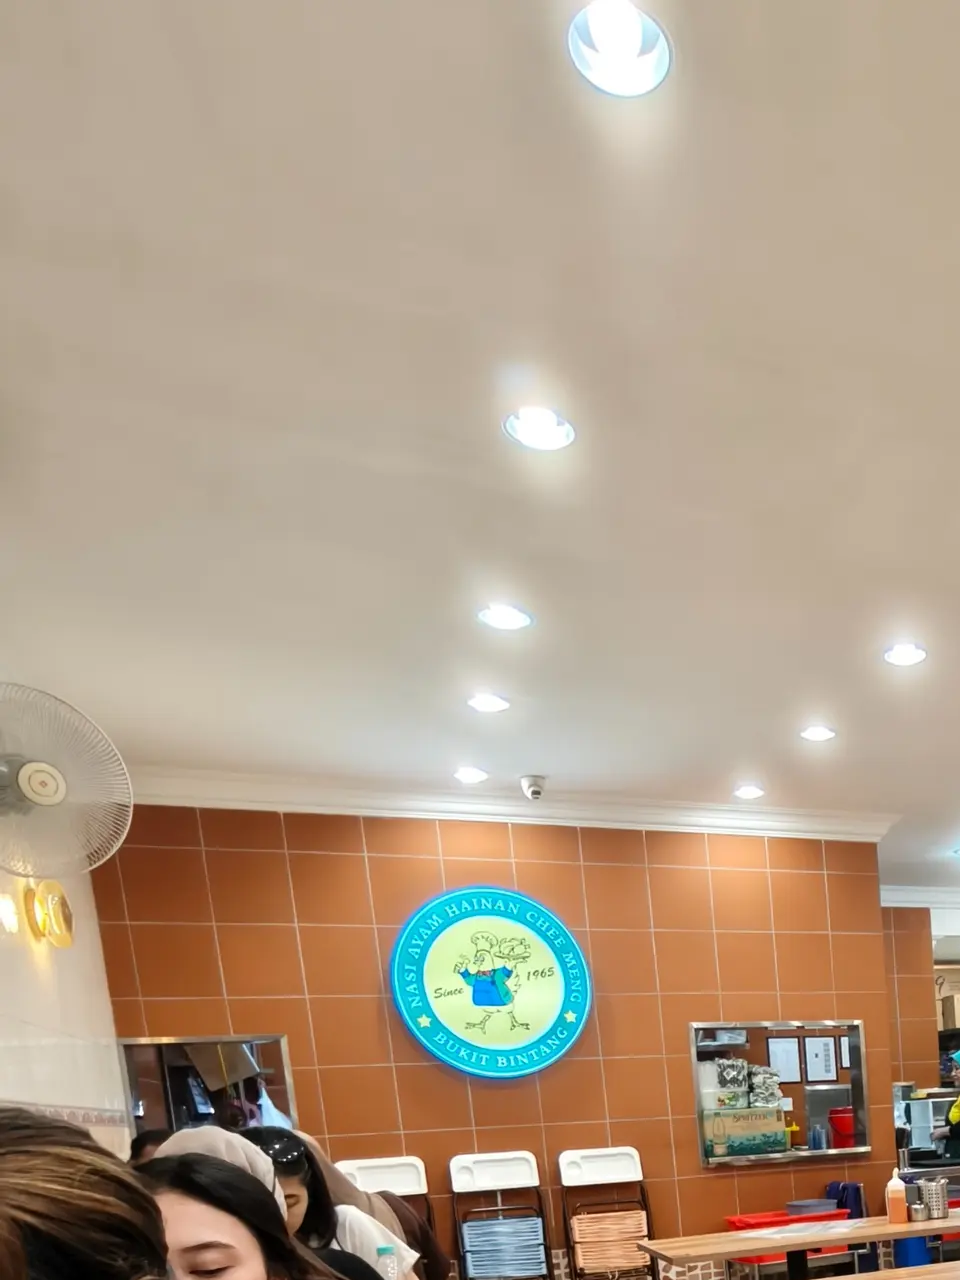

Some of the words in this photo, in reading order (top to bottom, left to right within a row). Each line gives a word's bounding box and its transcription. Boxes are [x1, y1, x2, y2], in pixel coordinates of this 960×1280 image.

[445, 897, 521, 917] HAINAN
[410, 913, 444, 959] AYAM
[526, 911, 566, 948] CHEE
[405, 964, 423, 1008] NASI
[433, 986, 464, 999] Since
[526, 967, 555, 981] 1965
[562, 951, 582, 1004] MENG
[433, 1031, 490, 1066] BUKIT
[497, 1027, 568, 1067] BINTANG
